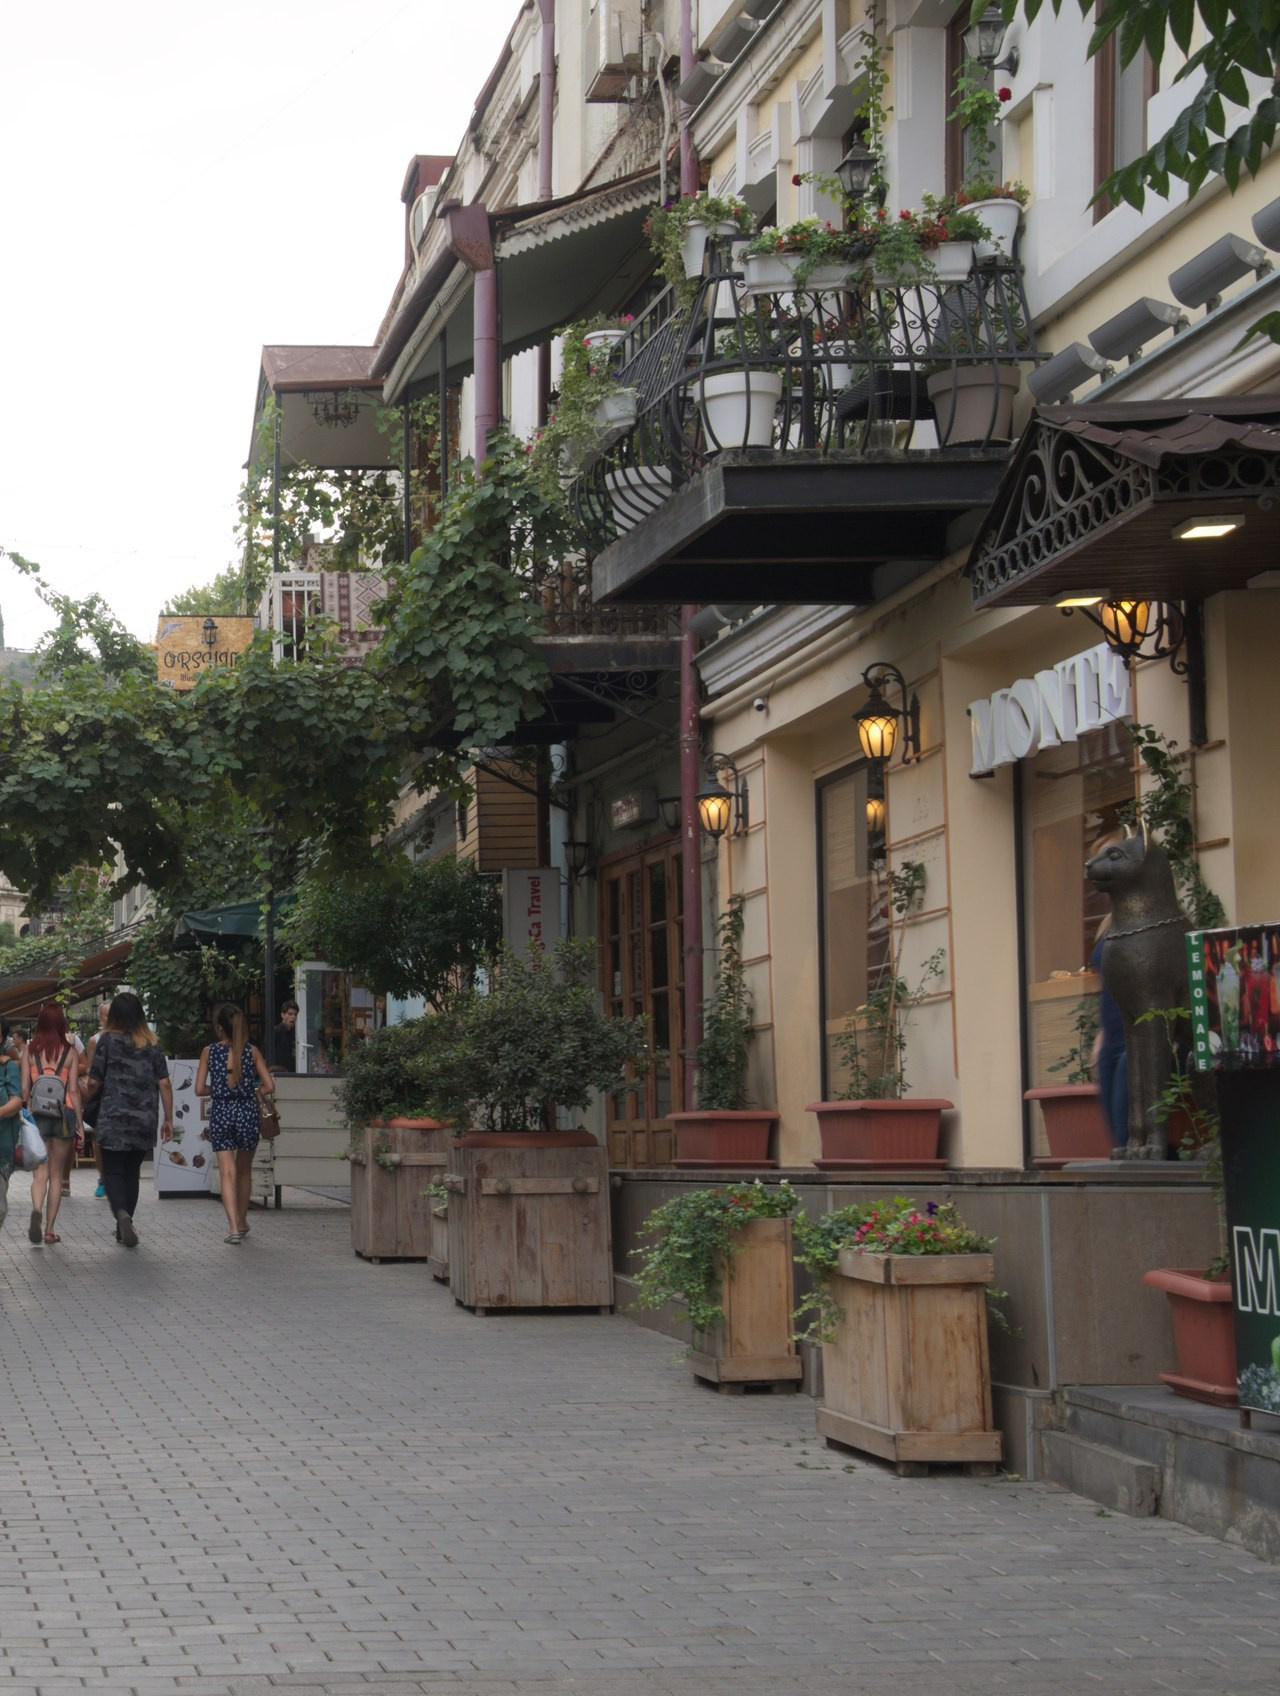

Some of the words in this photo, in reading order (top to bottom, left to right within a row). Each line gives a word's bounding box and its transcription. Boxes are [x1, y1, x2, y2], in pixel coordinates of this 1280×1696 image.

[968, 641, 1132, 775] MONTE
[527, 875, 541, 917] Travel
[1190, 934, 1207, 1070] LEMONADE
